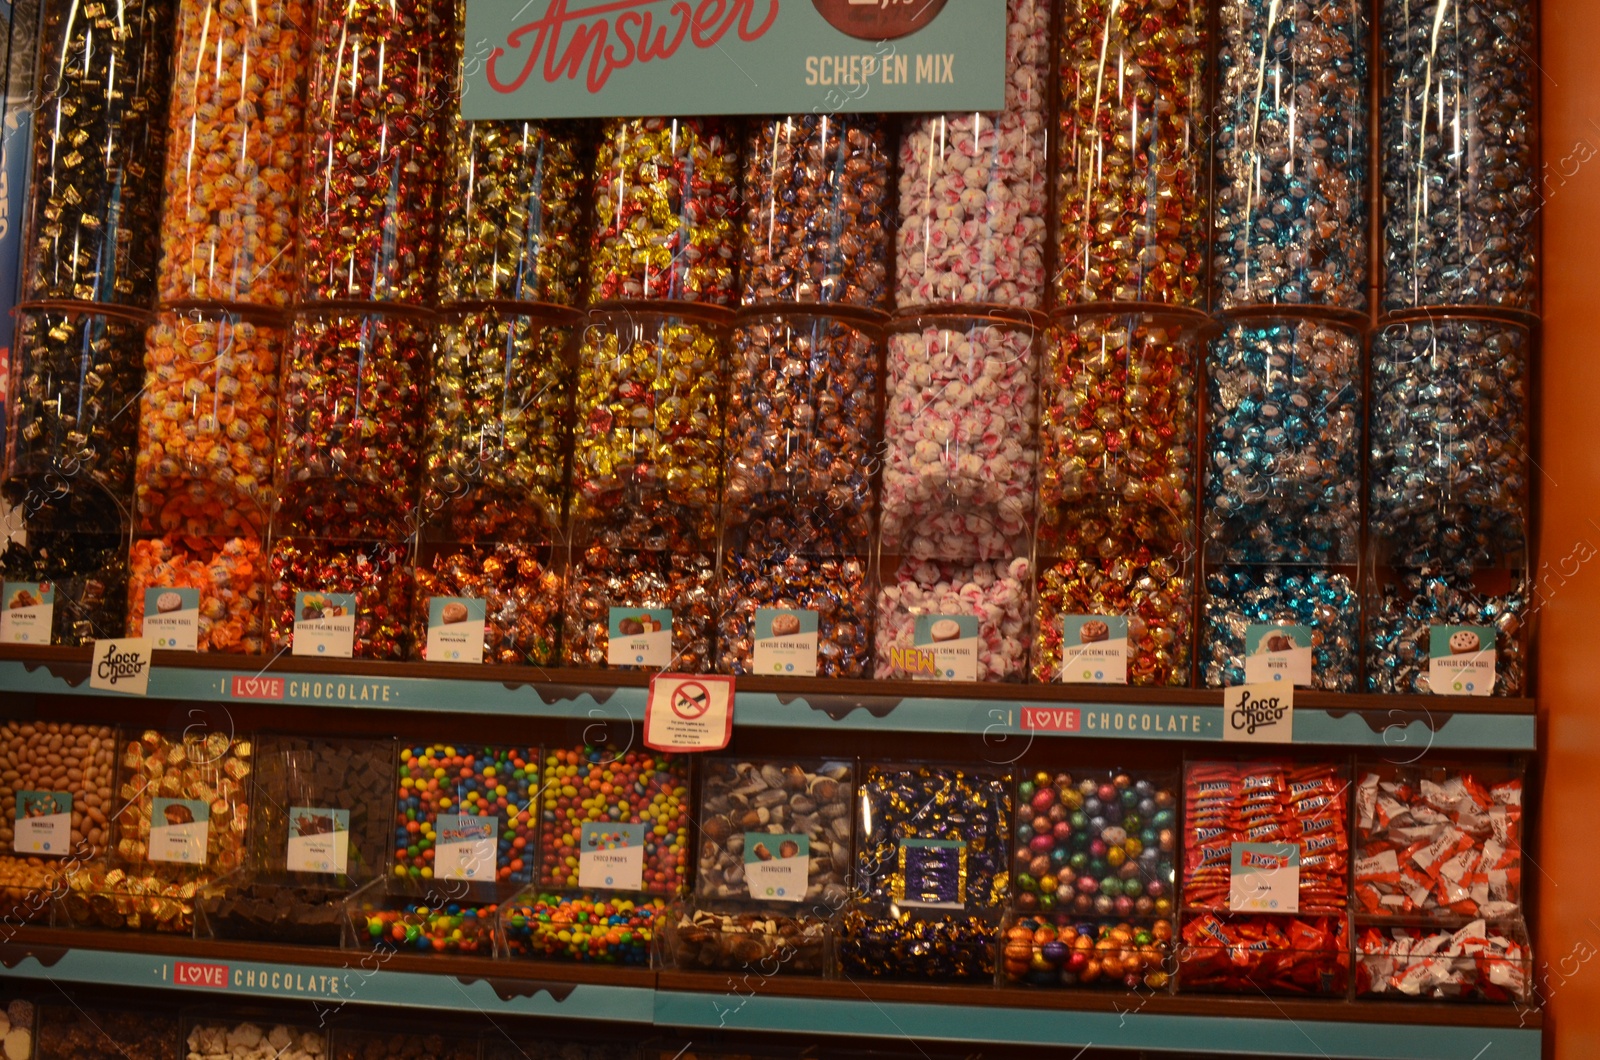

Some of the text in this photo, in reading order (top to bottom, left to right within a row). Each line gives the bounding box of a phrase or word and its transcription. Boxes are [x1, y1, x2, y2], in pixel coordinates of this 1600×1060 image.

[486, 0, 779, 93] Answer
[805, 54, 955, 86] SCHEP EN MIX
[103, 644, 140, 665] Loco
[889, 646, 935, 674] NEW
[956, 648, 971, 656] KOGEL
[1106, 650, 1120, 658] KOGEL
[98, 661, 147, 684] Choco
[220, 678, 225, 694] I
[289, 681, 391, 702] CHOCOLATE
[1235, 690, 1280, 713] Loco
[1008, 709, 1012, 727] I
[1087, 711, 1202, 733] CHOCOLATE
[1231, 705, 1289, 735] Choco
[1301, 818, 1334, 836] Daim
[1306, 834, 1337, 853] Daim
[1429, 835, 1450, 858] bueno
[593, 854, 609, 863] CHOCO
[760, 866, 792, 874] ZEEVRUCHTEN
[162, 964, 167, 980] I
[234, 969, 339, 993] CHOCOLATE
